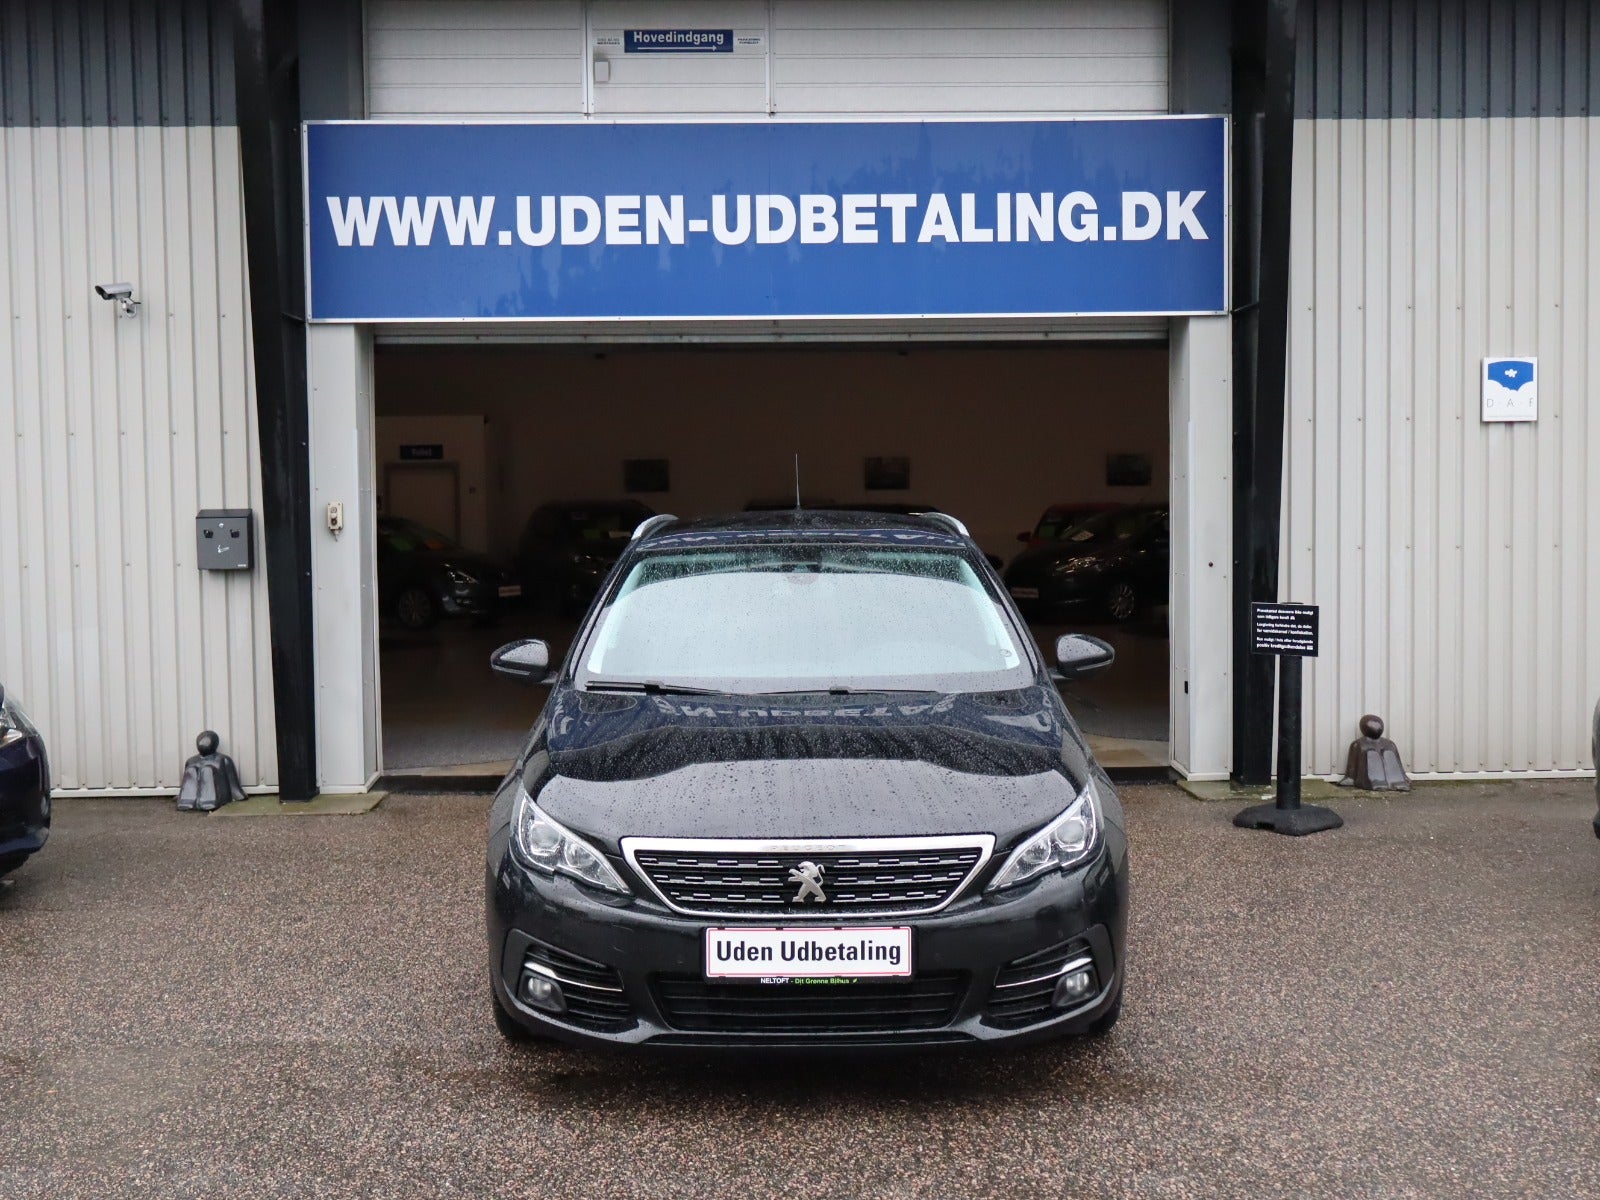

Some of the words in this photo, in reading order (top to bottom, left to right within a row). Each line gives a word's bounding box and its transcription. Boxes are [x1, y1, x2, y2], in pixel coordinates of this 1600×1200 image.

[633, 31, 724, 45] Hovedindgang
[326, 190, 1210, 247] WWW.UDEN-UDBETALING.DK
[717, 941, 773, 961] Uden
[781, 940, 901, 965] Udbetaling
